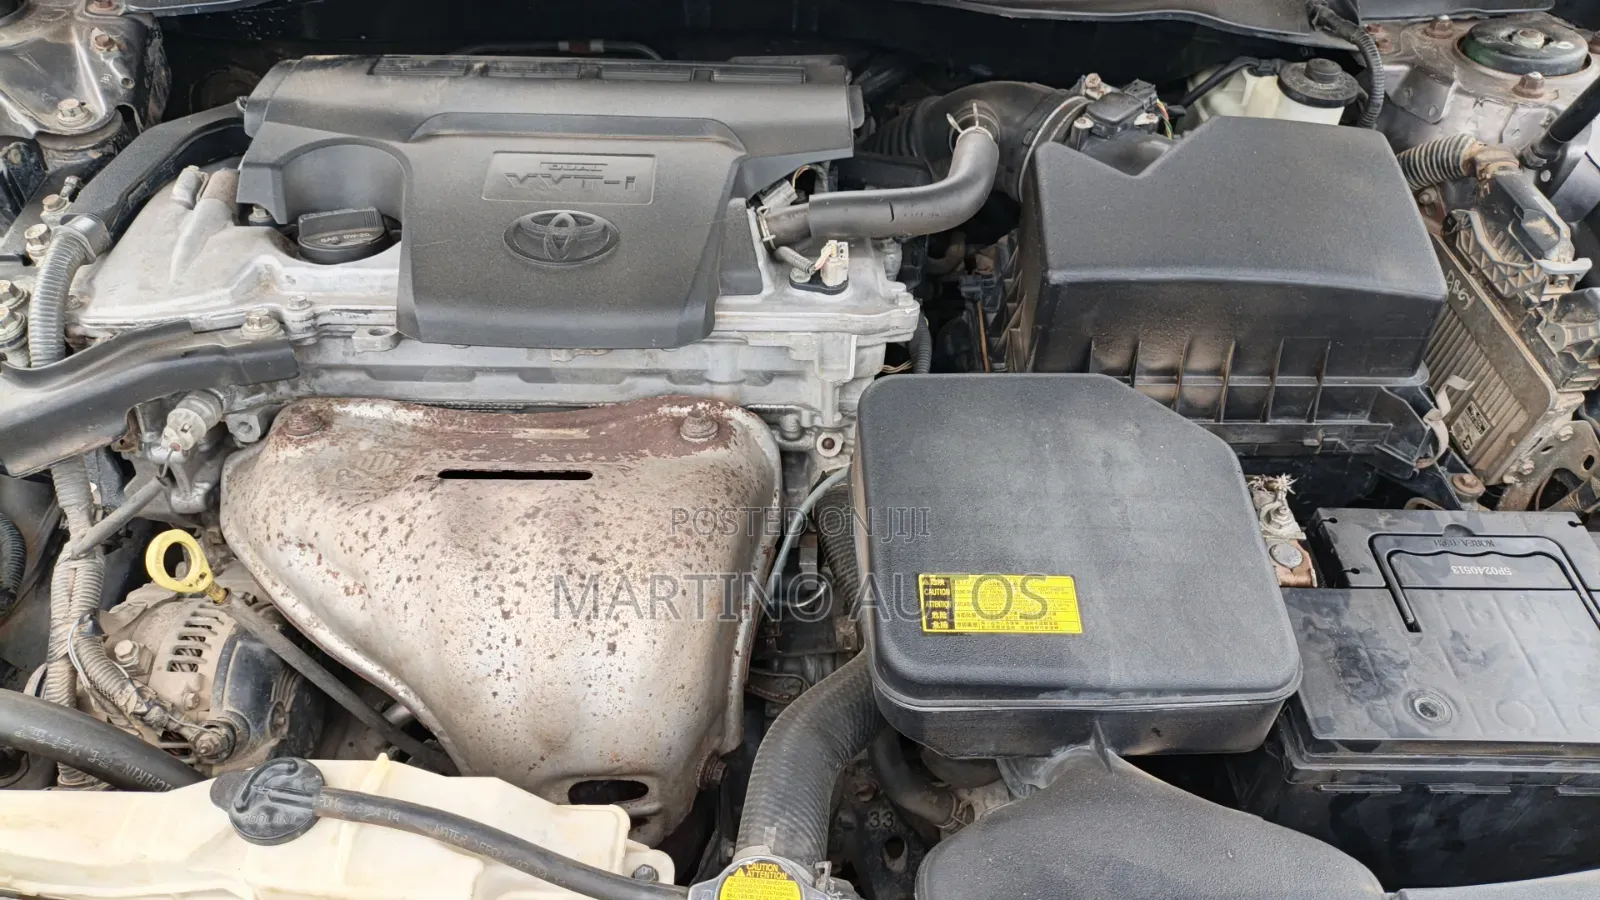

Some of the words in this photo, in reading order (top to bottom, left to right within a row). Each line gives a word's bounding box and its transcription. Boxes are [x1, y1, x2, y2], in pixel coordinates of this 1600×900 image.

[924, 588, 951, 596] CAUTION
[925, 600, 951, 608] ATTENTION
[121, 763, 176, 792] ICHIRIN
[869, 810, 894, 828] 33
[746, 863, 779, 872] CAUTION
[746, 870, 788, 881] ATTENTION
